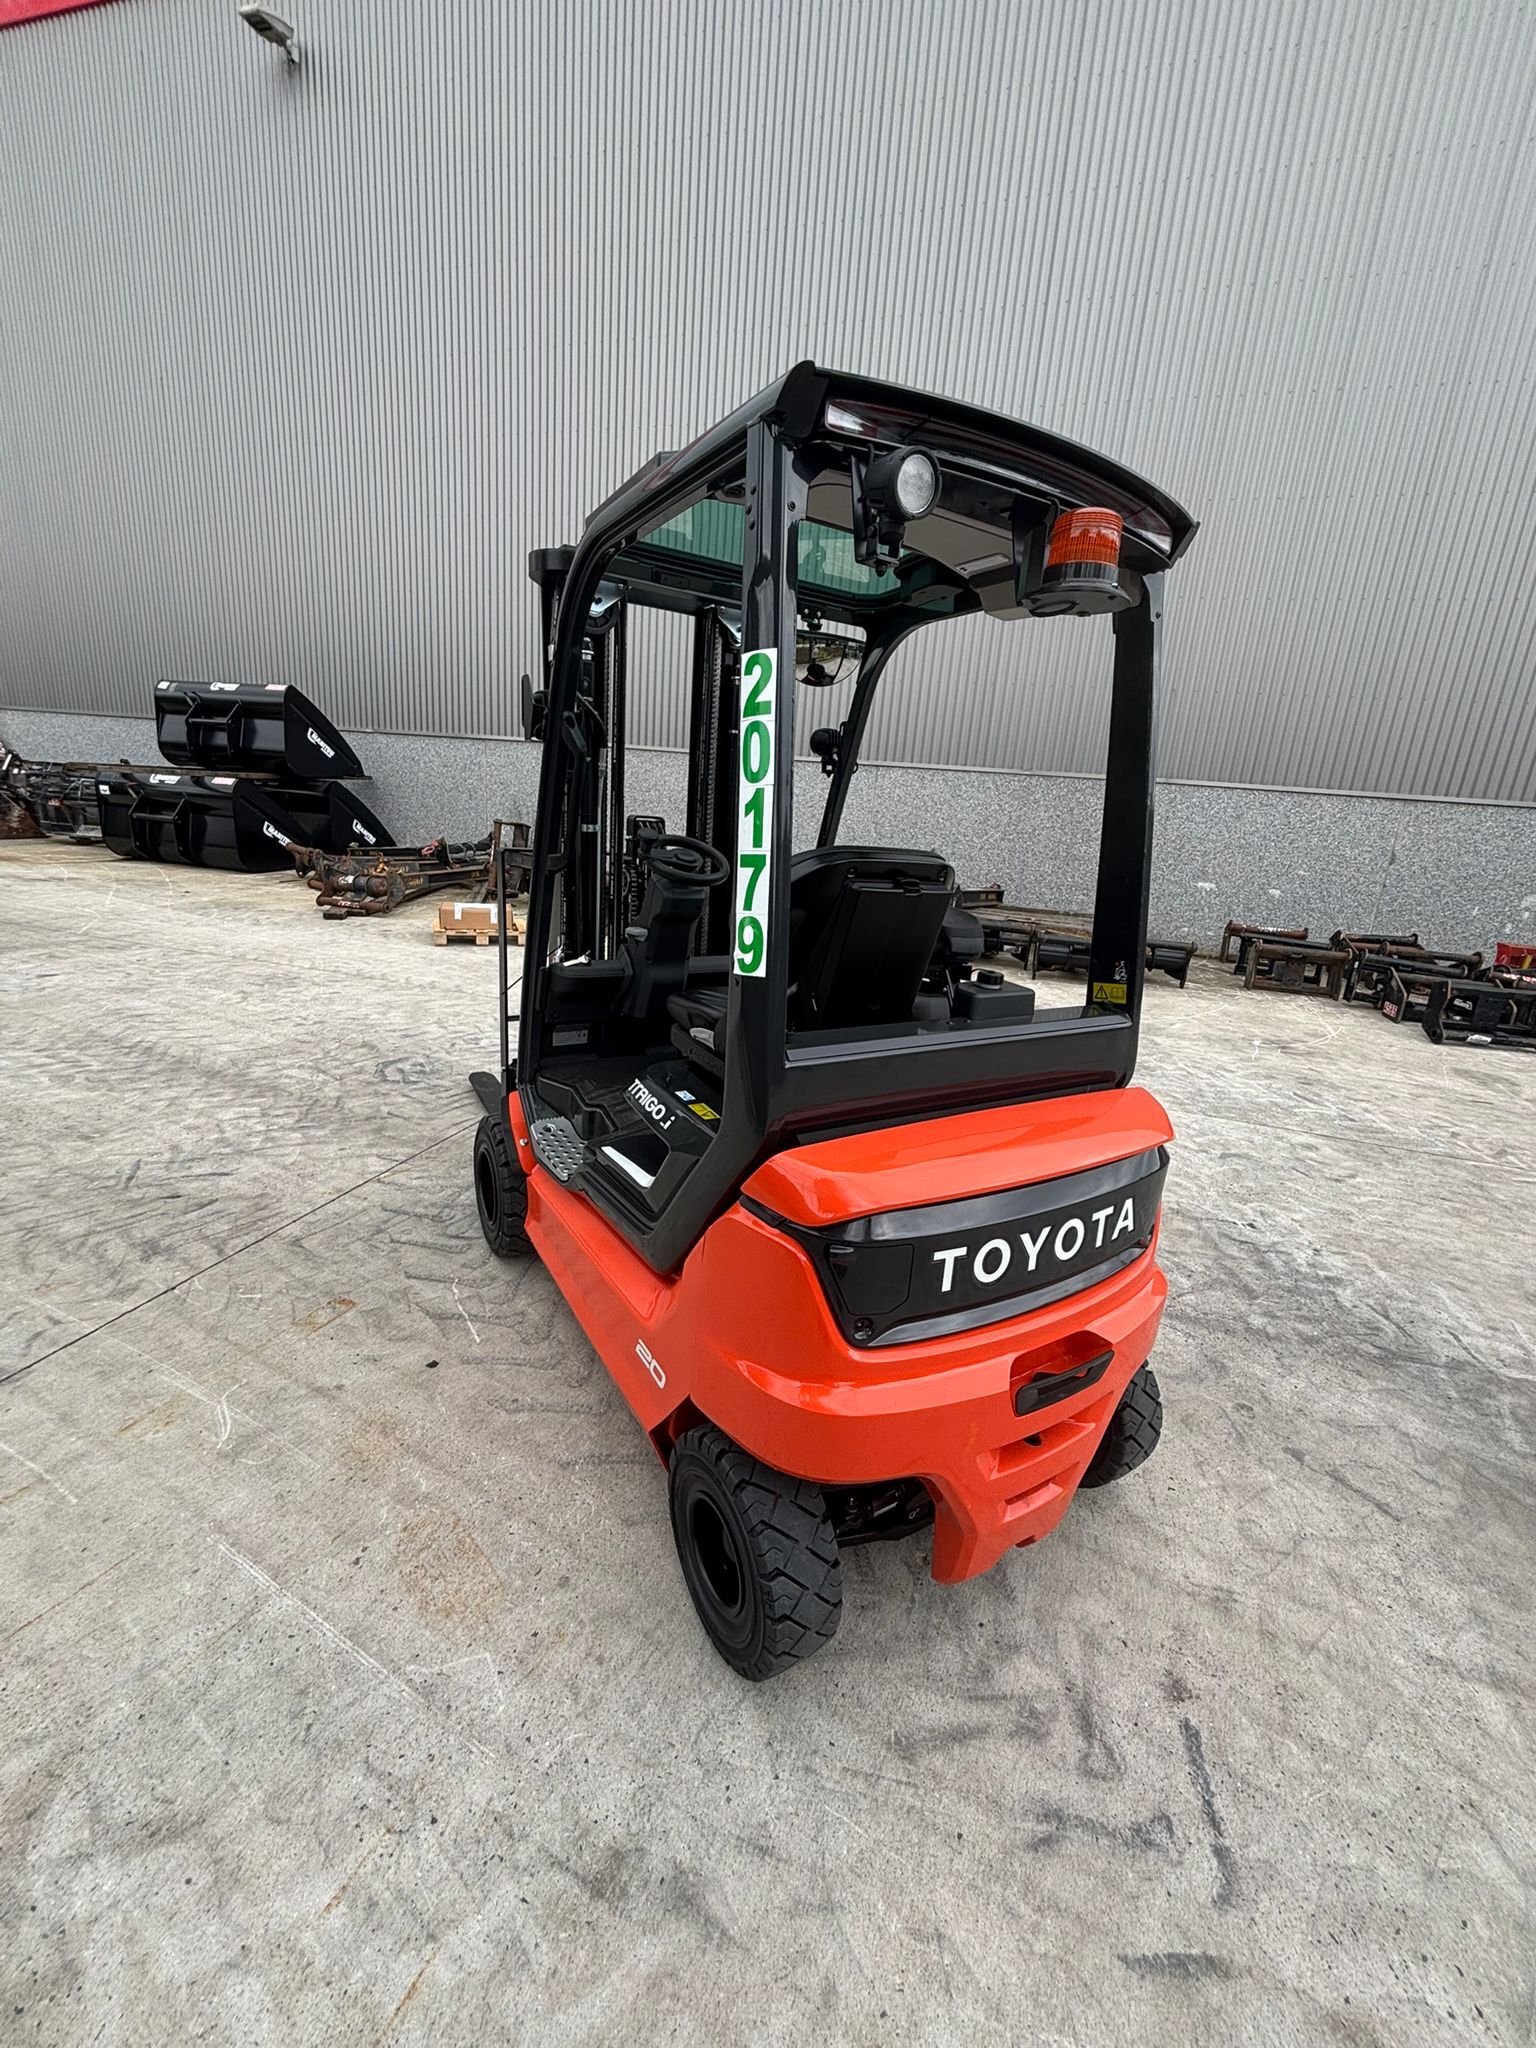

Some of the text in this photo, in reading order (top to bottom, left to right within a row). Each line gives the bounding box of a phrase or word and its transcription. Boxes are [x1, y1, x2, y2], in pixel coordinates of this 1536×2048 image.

[737, 652, 773, 974] 20179
[933, 1198, 1134, 1292] TOYOTA
[635, 1338, 667, 1389] 20
